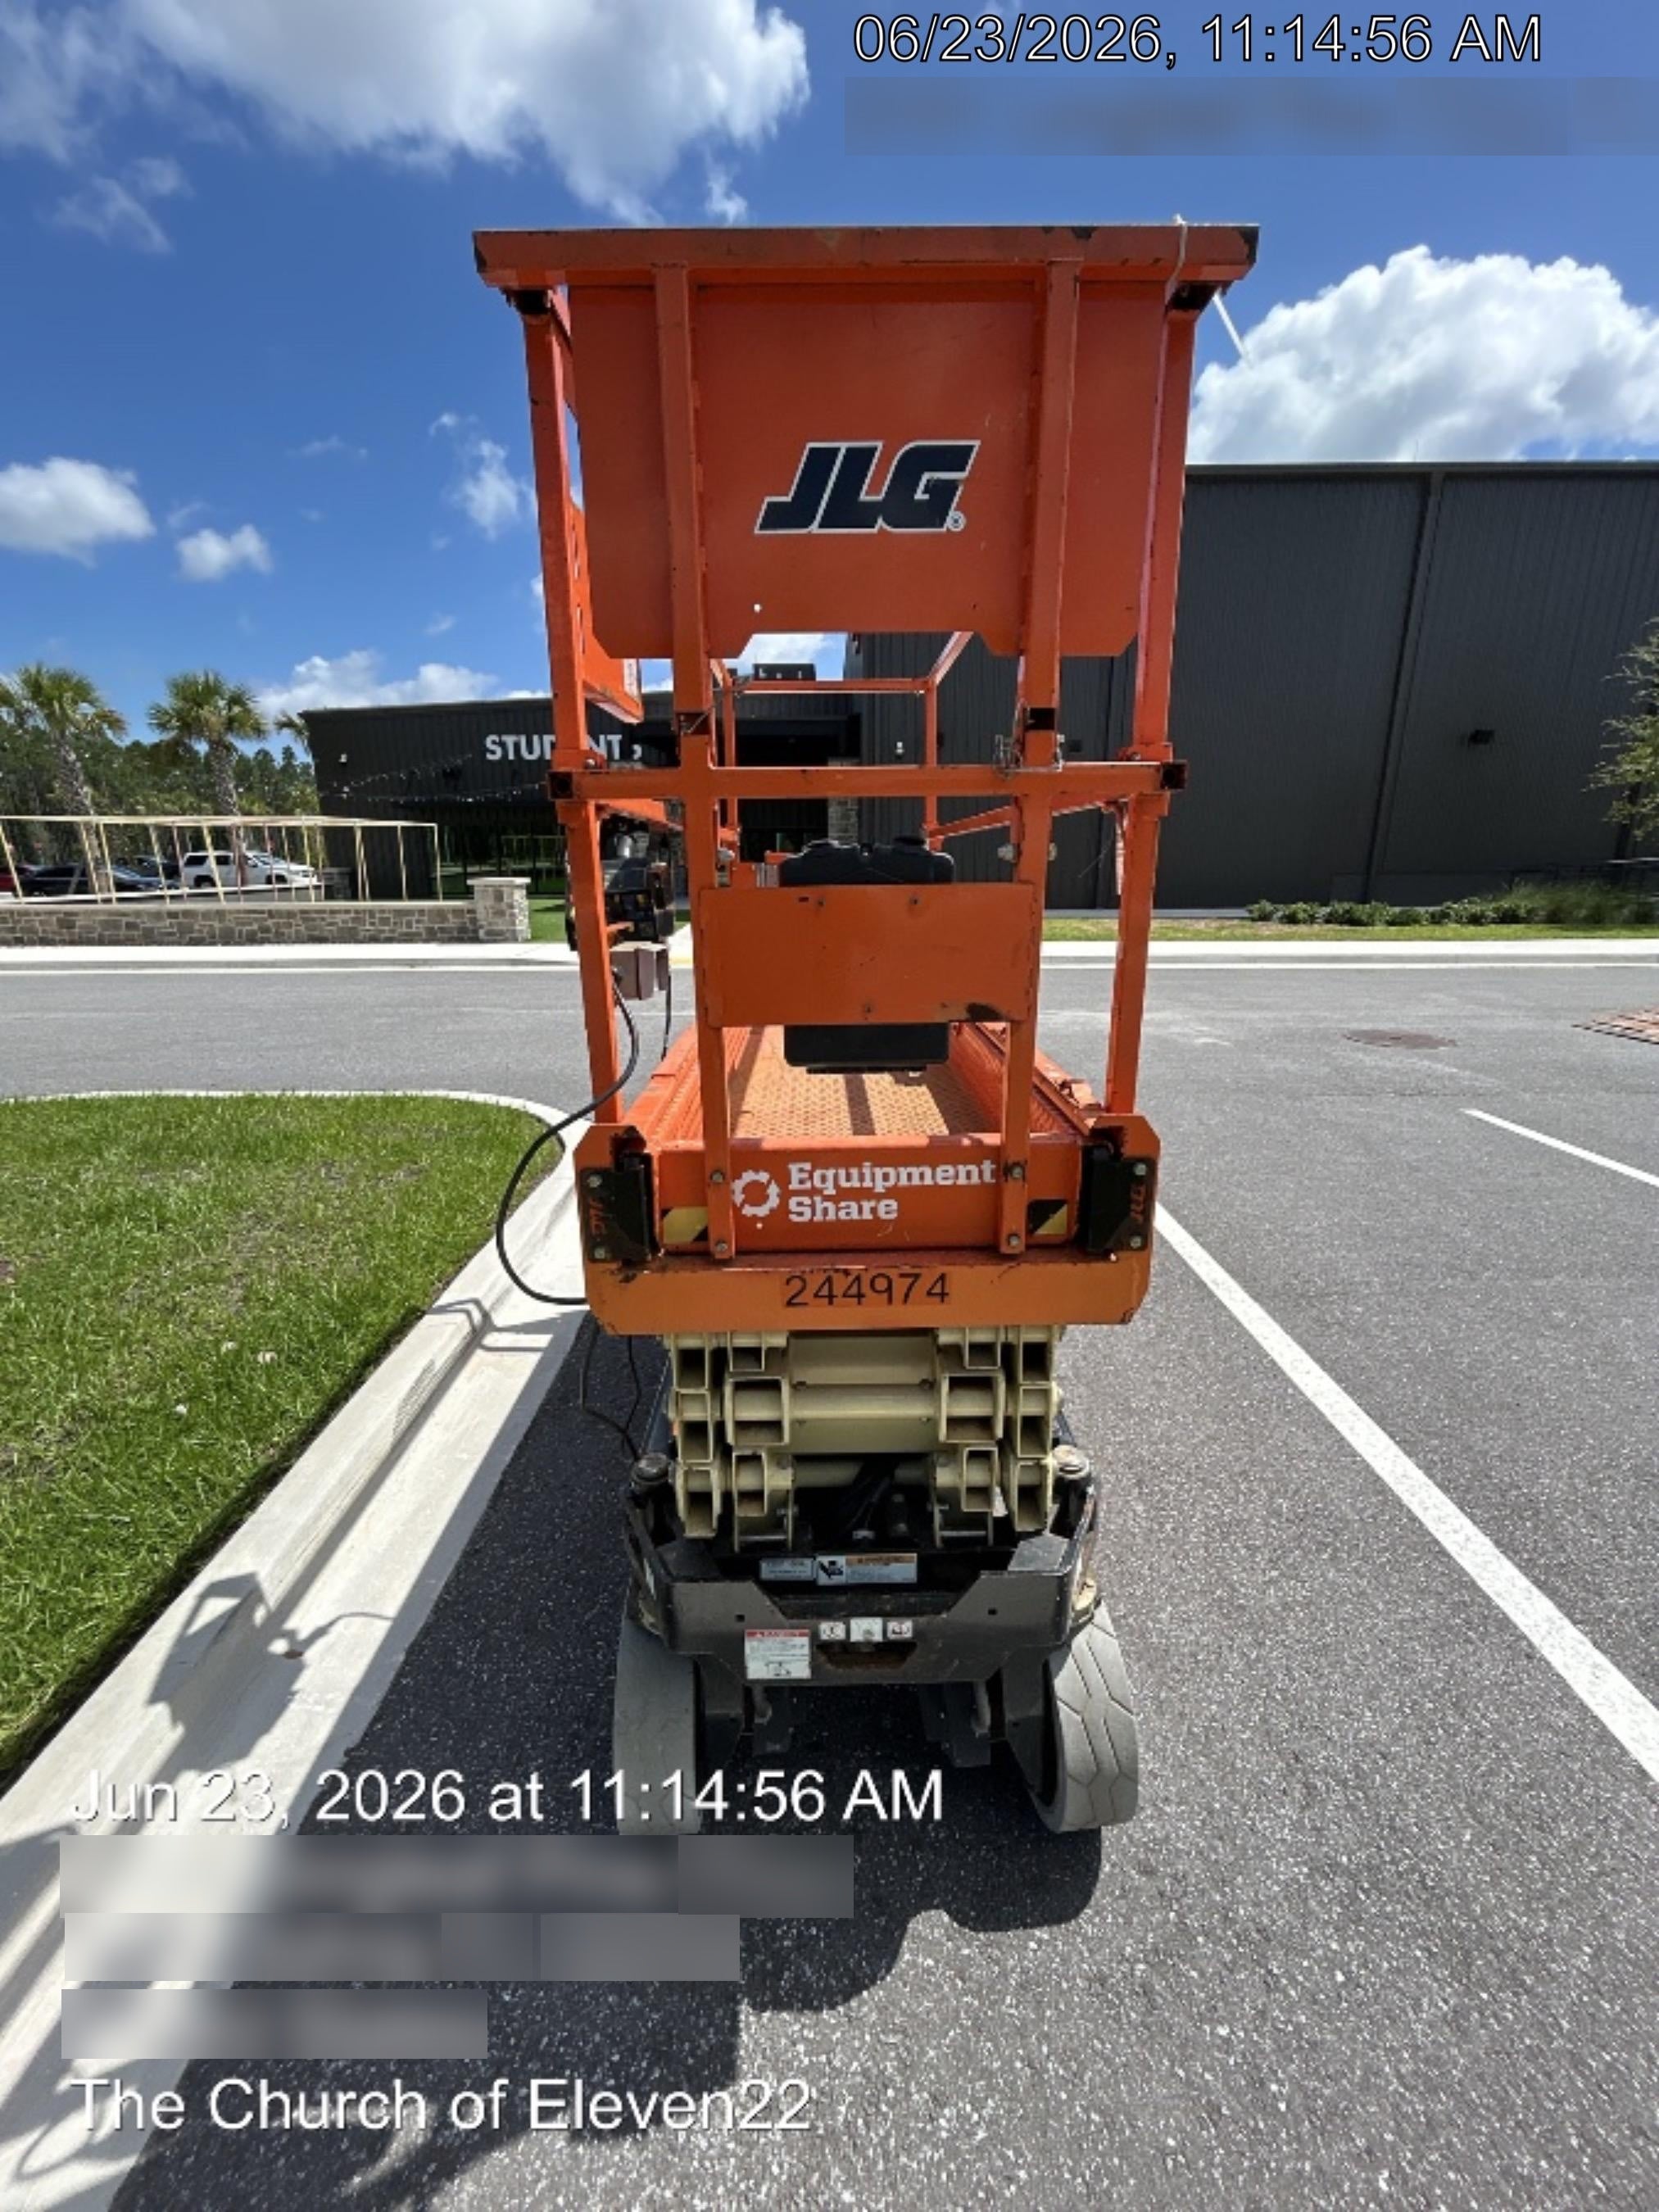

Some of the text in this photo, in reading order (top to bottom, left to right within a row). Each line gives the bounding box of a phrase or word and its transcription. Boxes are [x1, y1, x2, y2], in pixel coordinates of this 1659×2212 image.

[755, 439, 981, 533] JLG
[788, 1158, 997, 1194] Equipment
[788, 1195, 898, 1222] Share
[785, 1271, 950, 1308] 244974
